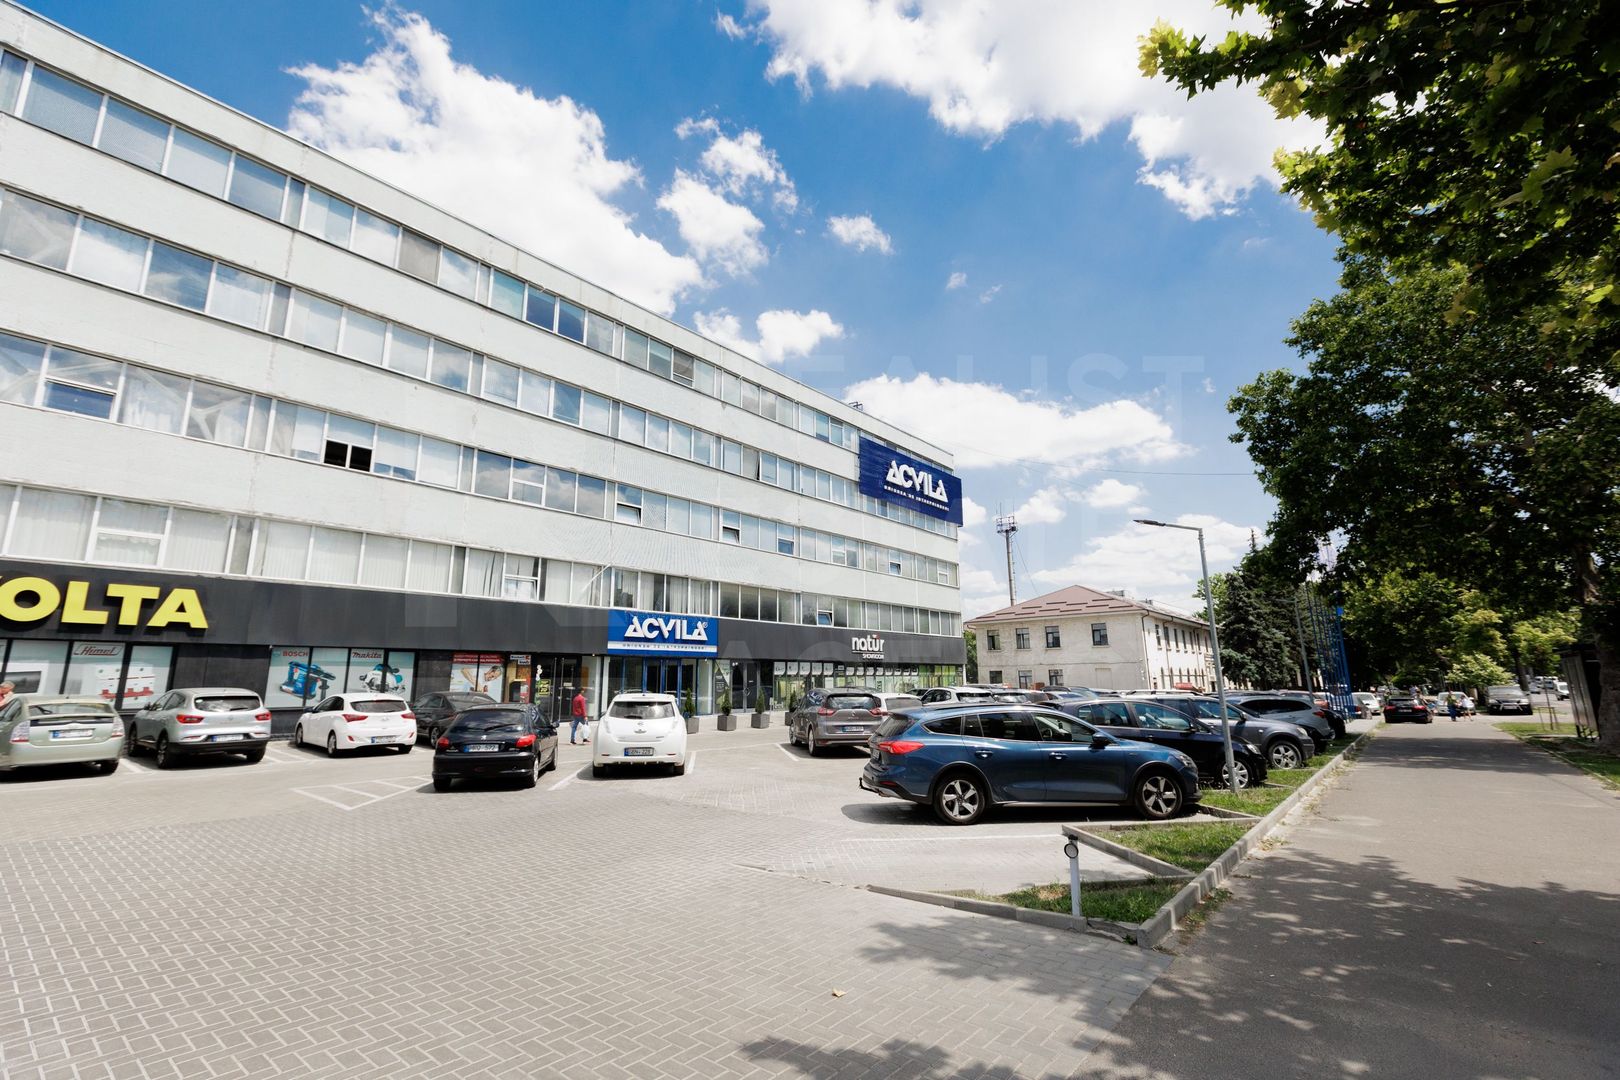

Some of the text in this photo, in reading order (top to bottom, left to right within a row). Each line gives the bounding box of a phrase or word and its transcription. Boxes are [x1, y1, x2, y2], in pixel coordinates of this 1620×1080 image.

[886, 460, 949, 502] ACVILA
[0, 576, 209, 629] OLTA
[624, 616, 708, 640] ACVILA
